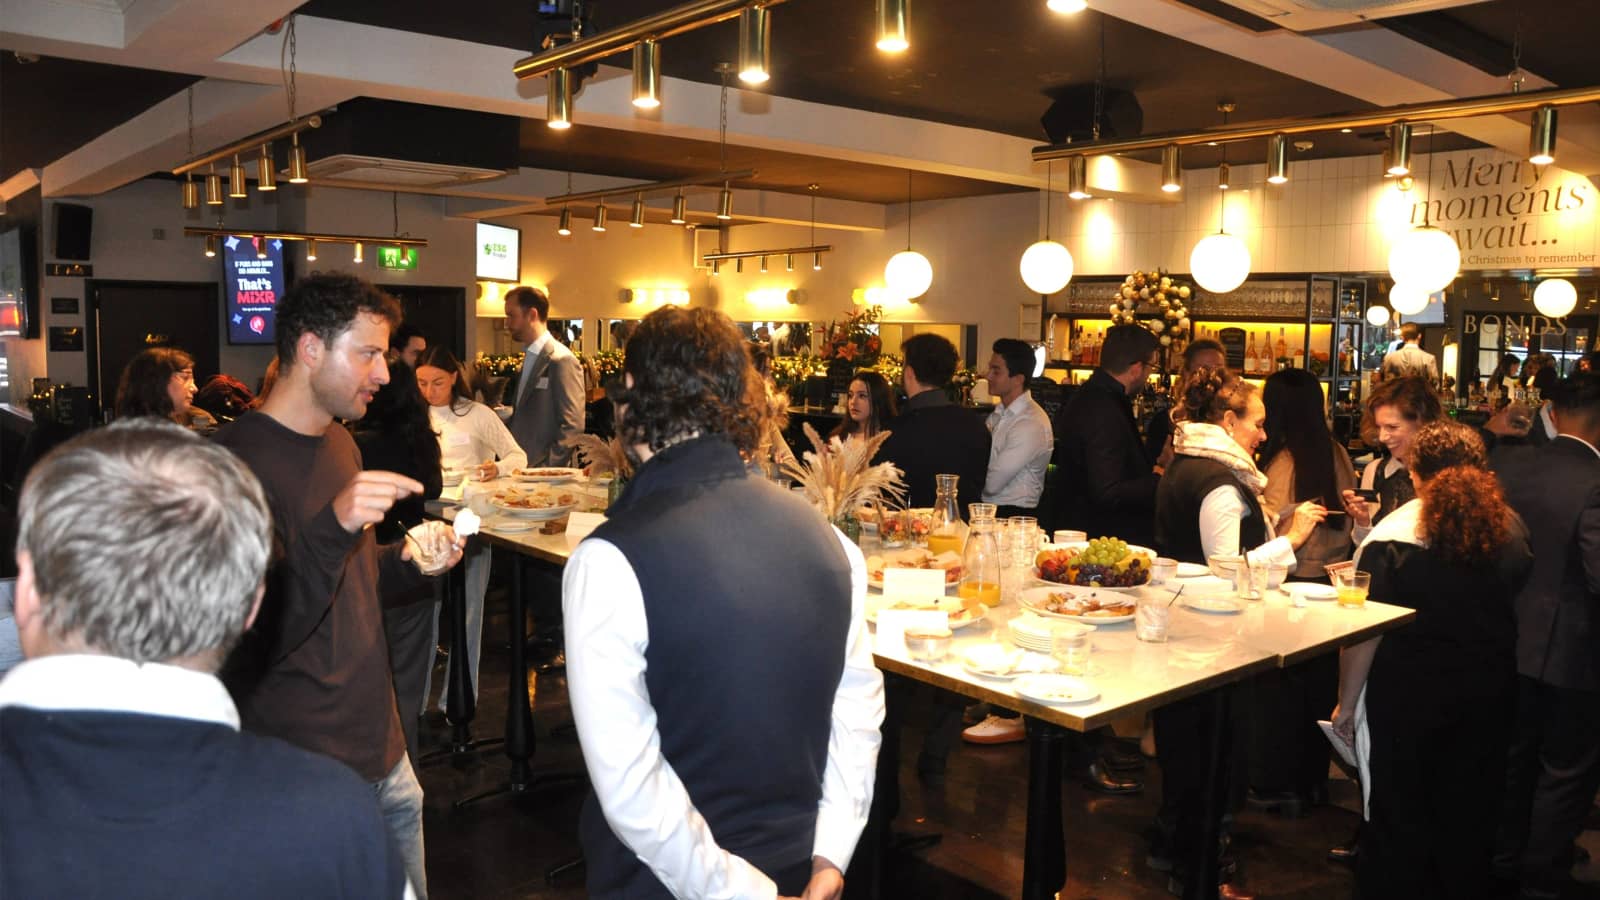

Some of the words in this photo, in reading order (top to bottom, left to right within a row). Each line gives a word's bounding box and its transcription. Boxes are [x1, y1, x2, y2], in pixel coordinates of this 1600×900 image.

[1441, 156, 1549, 190] Merry
[1410, 185, 1587, 224] moments
[1448, 215, 1558, 251] wait...
[1467, 255, 1522, 265] Christmas
[1525, 254, 1536, 263] to
[1538, 252, 1596, 264] remember
[237, 278, 272, 291] That's
[1463, 314, 1568, 336] BONDS
